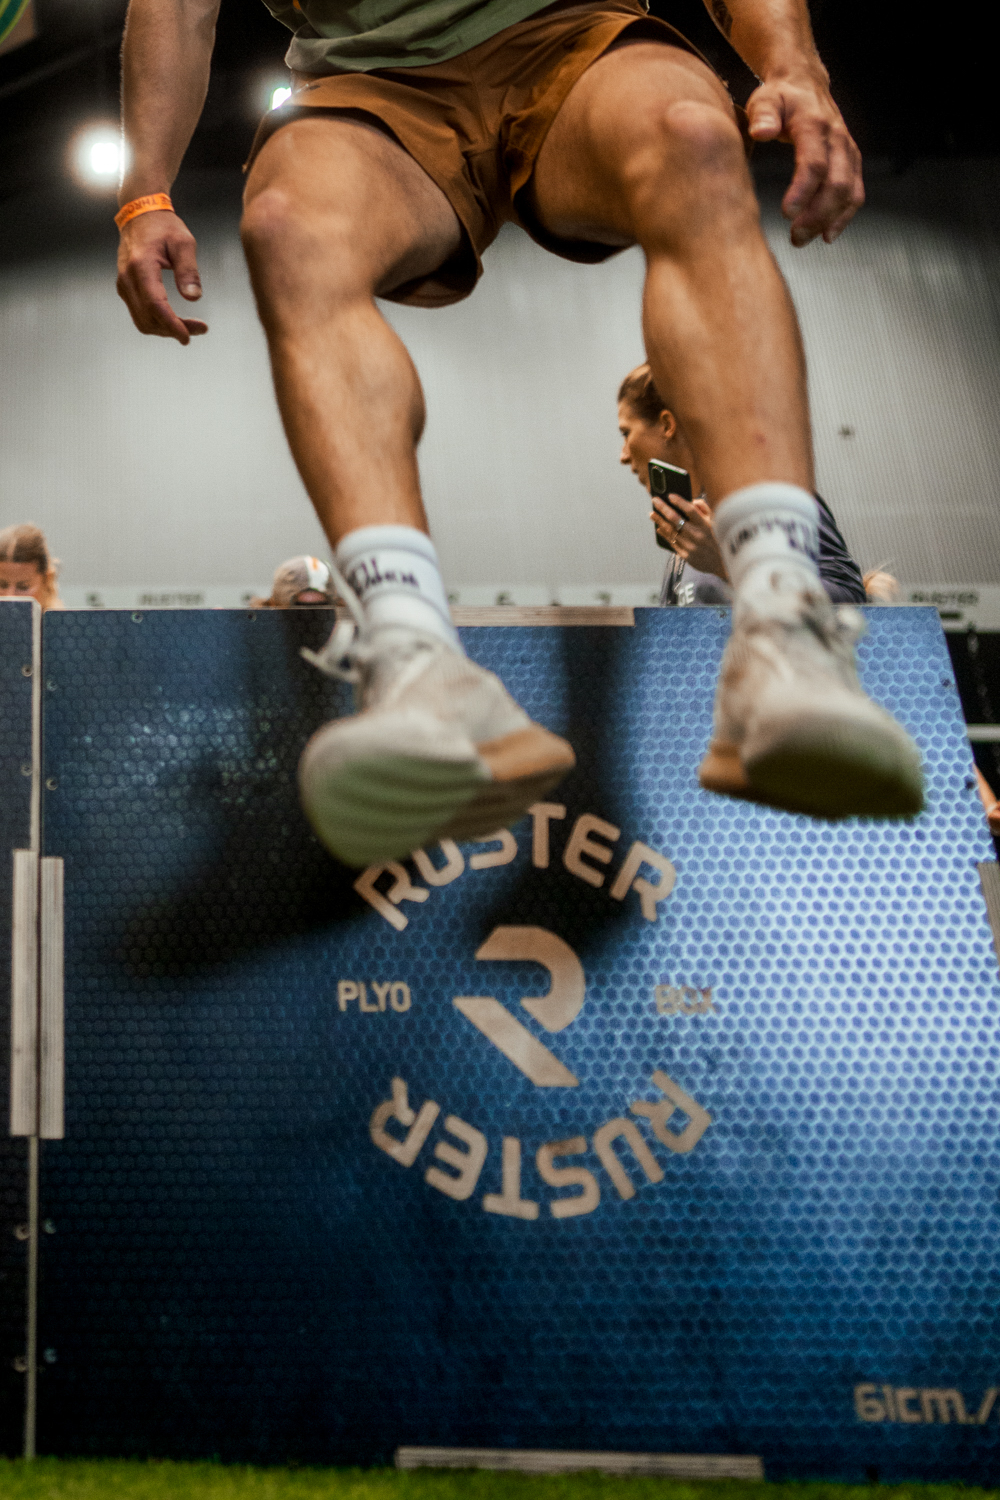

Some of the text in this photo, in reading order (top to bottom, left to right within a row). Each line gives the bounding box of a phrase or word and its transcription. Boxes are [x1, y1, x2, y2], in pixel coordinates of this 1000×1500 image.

[352, 802, 677, 931] RUSTER
[337, 980, 412, 1013] PLYO
[369, 1069, 712, 1220] RUSTER
